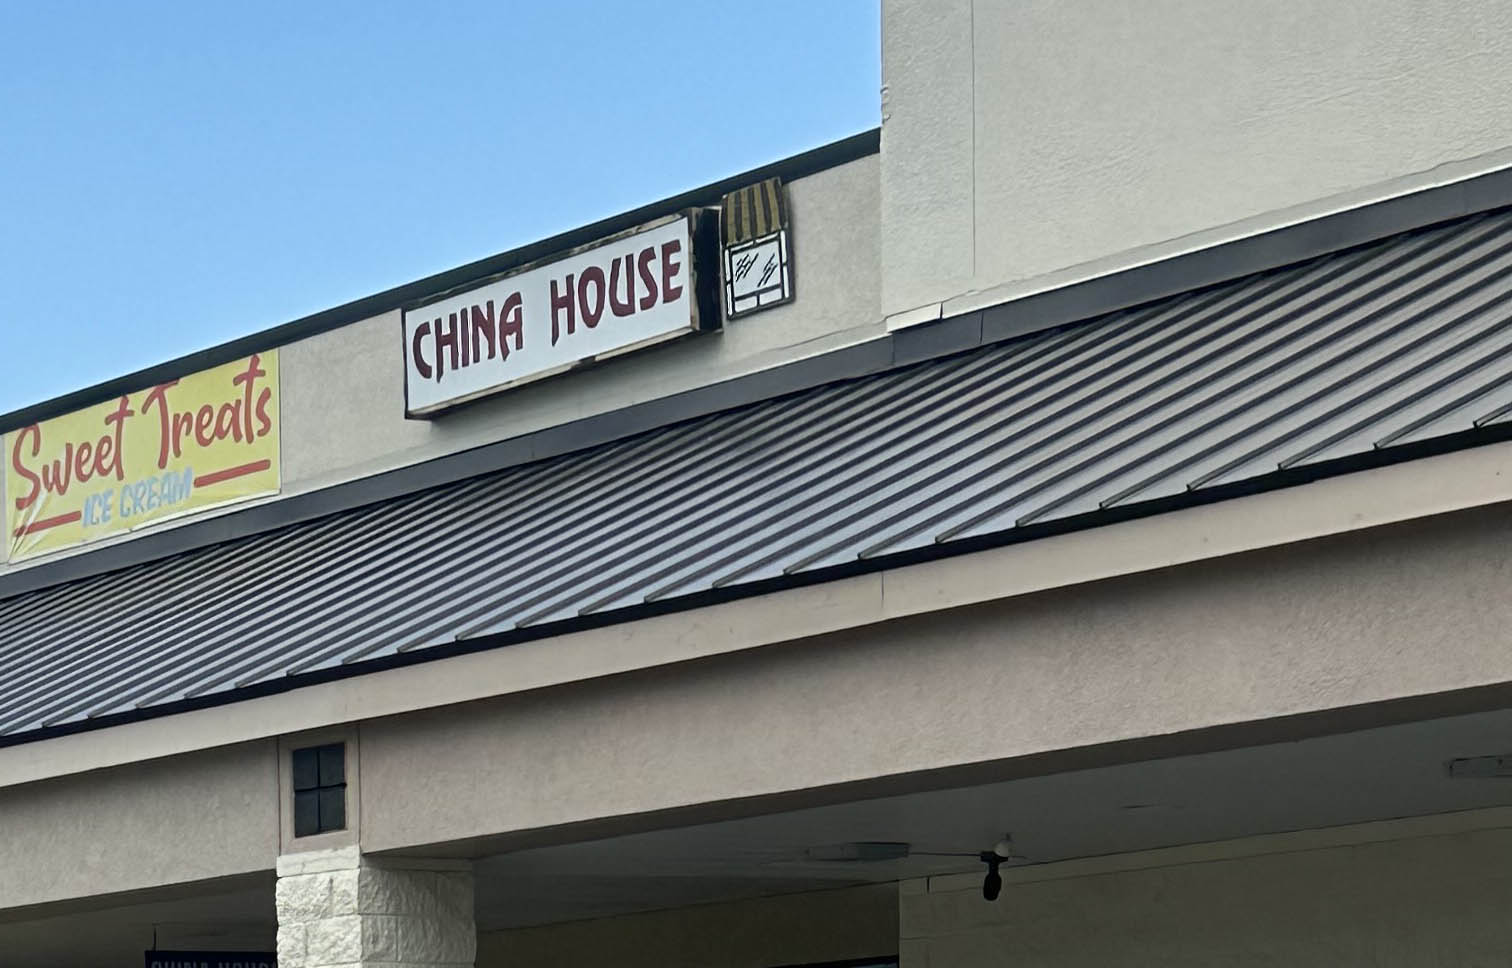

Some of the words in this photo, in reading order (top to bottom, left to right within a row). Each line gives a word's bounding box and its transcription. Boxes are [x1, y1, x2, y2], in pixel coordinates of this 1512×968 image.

[413, 291, 524, 383] CHINA
[550, 239, 684, 347] HOUSE
[12, 394, 135, 510] Sweet
[141, 353, 272, 470] Treats
[82, 488, 114, 528] ICE
[119, 466, 194, 518] CREAM
